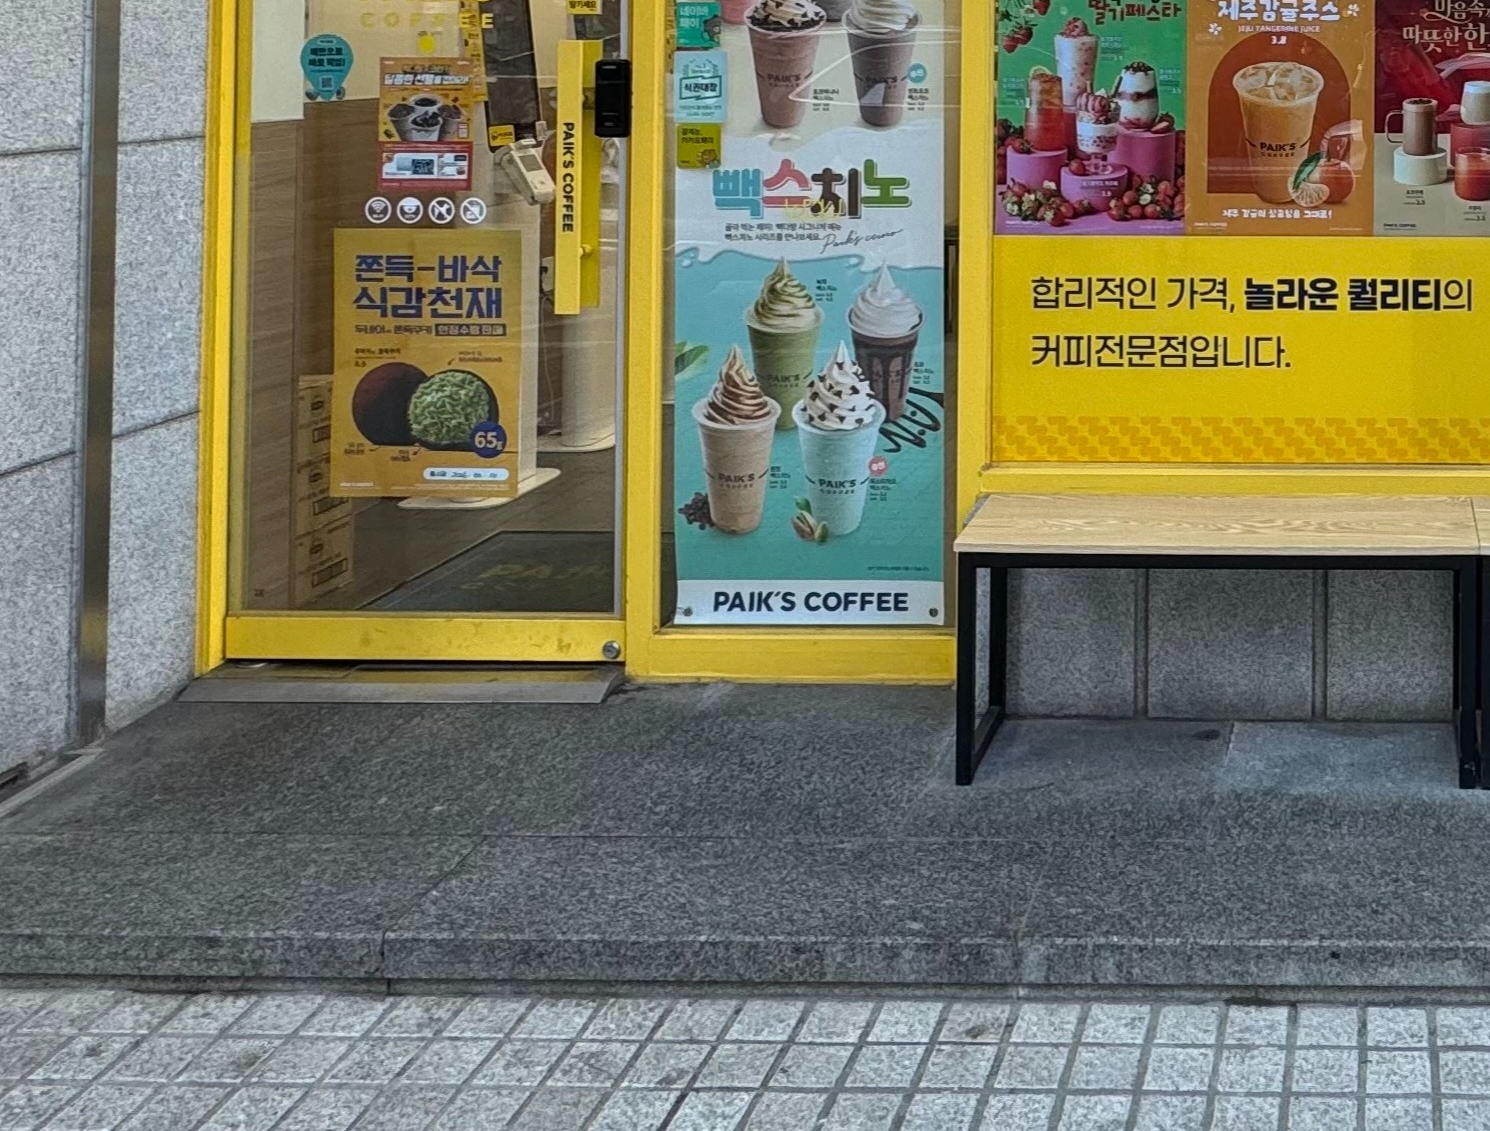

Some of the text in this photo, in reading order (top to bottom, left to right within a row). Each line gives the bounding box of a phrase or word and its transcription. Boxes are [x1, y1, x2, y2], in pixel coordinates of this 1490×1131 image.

[360, 13, 494, 29] COFFEE
[1259, 142, 1296, 152] PAIK'S
[562, 122, 574, 232] PAIK'S COFFEE
[712, 158, 912, 220] 빽스치노
[353, 286, 503, 319] 식감천재
[1031, 277, 1473, 313] 합리적인 가격, 놀라운 퀄리티의
[1031, 334, 1292, 368] 커피전문점입니다.
[718, 472, 755, 483] PAIK'S
[819, 479, 857, 488] PAIK'S
[713, 590, 909, 612] PAIK'S COFFEE
